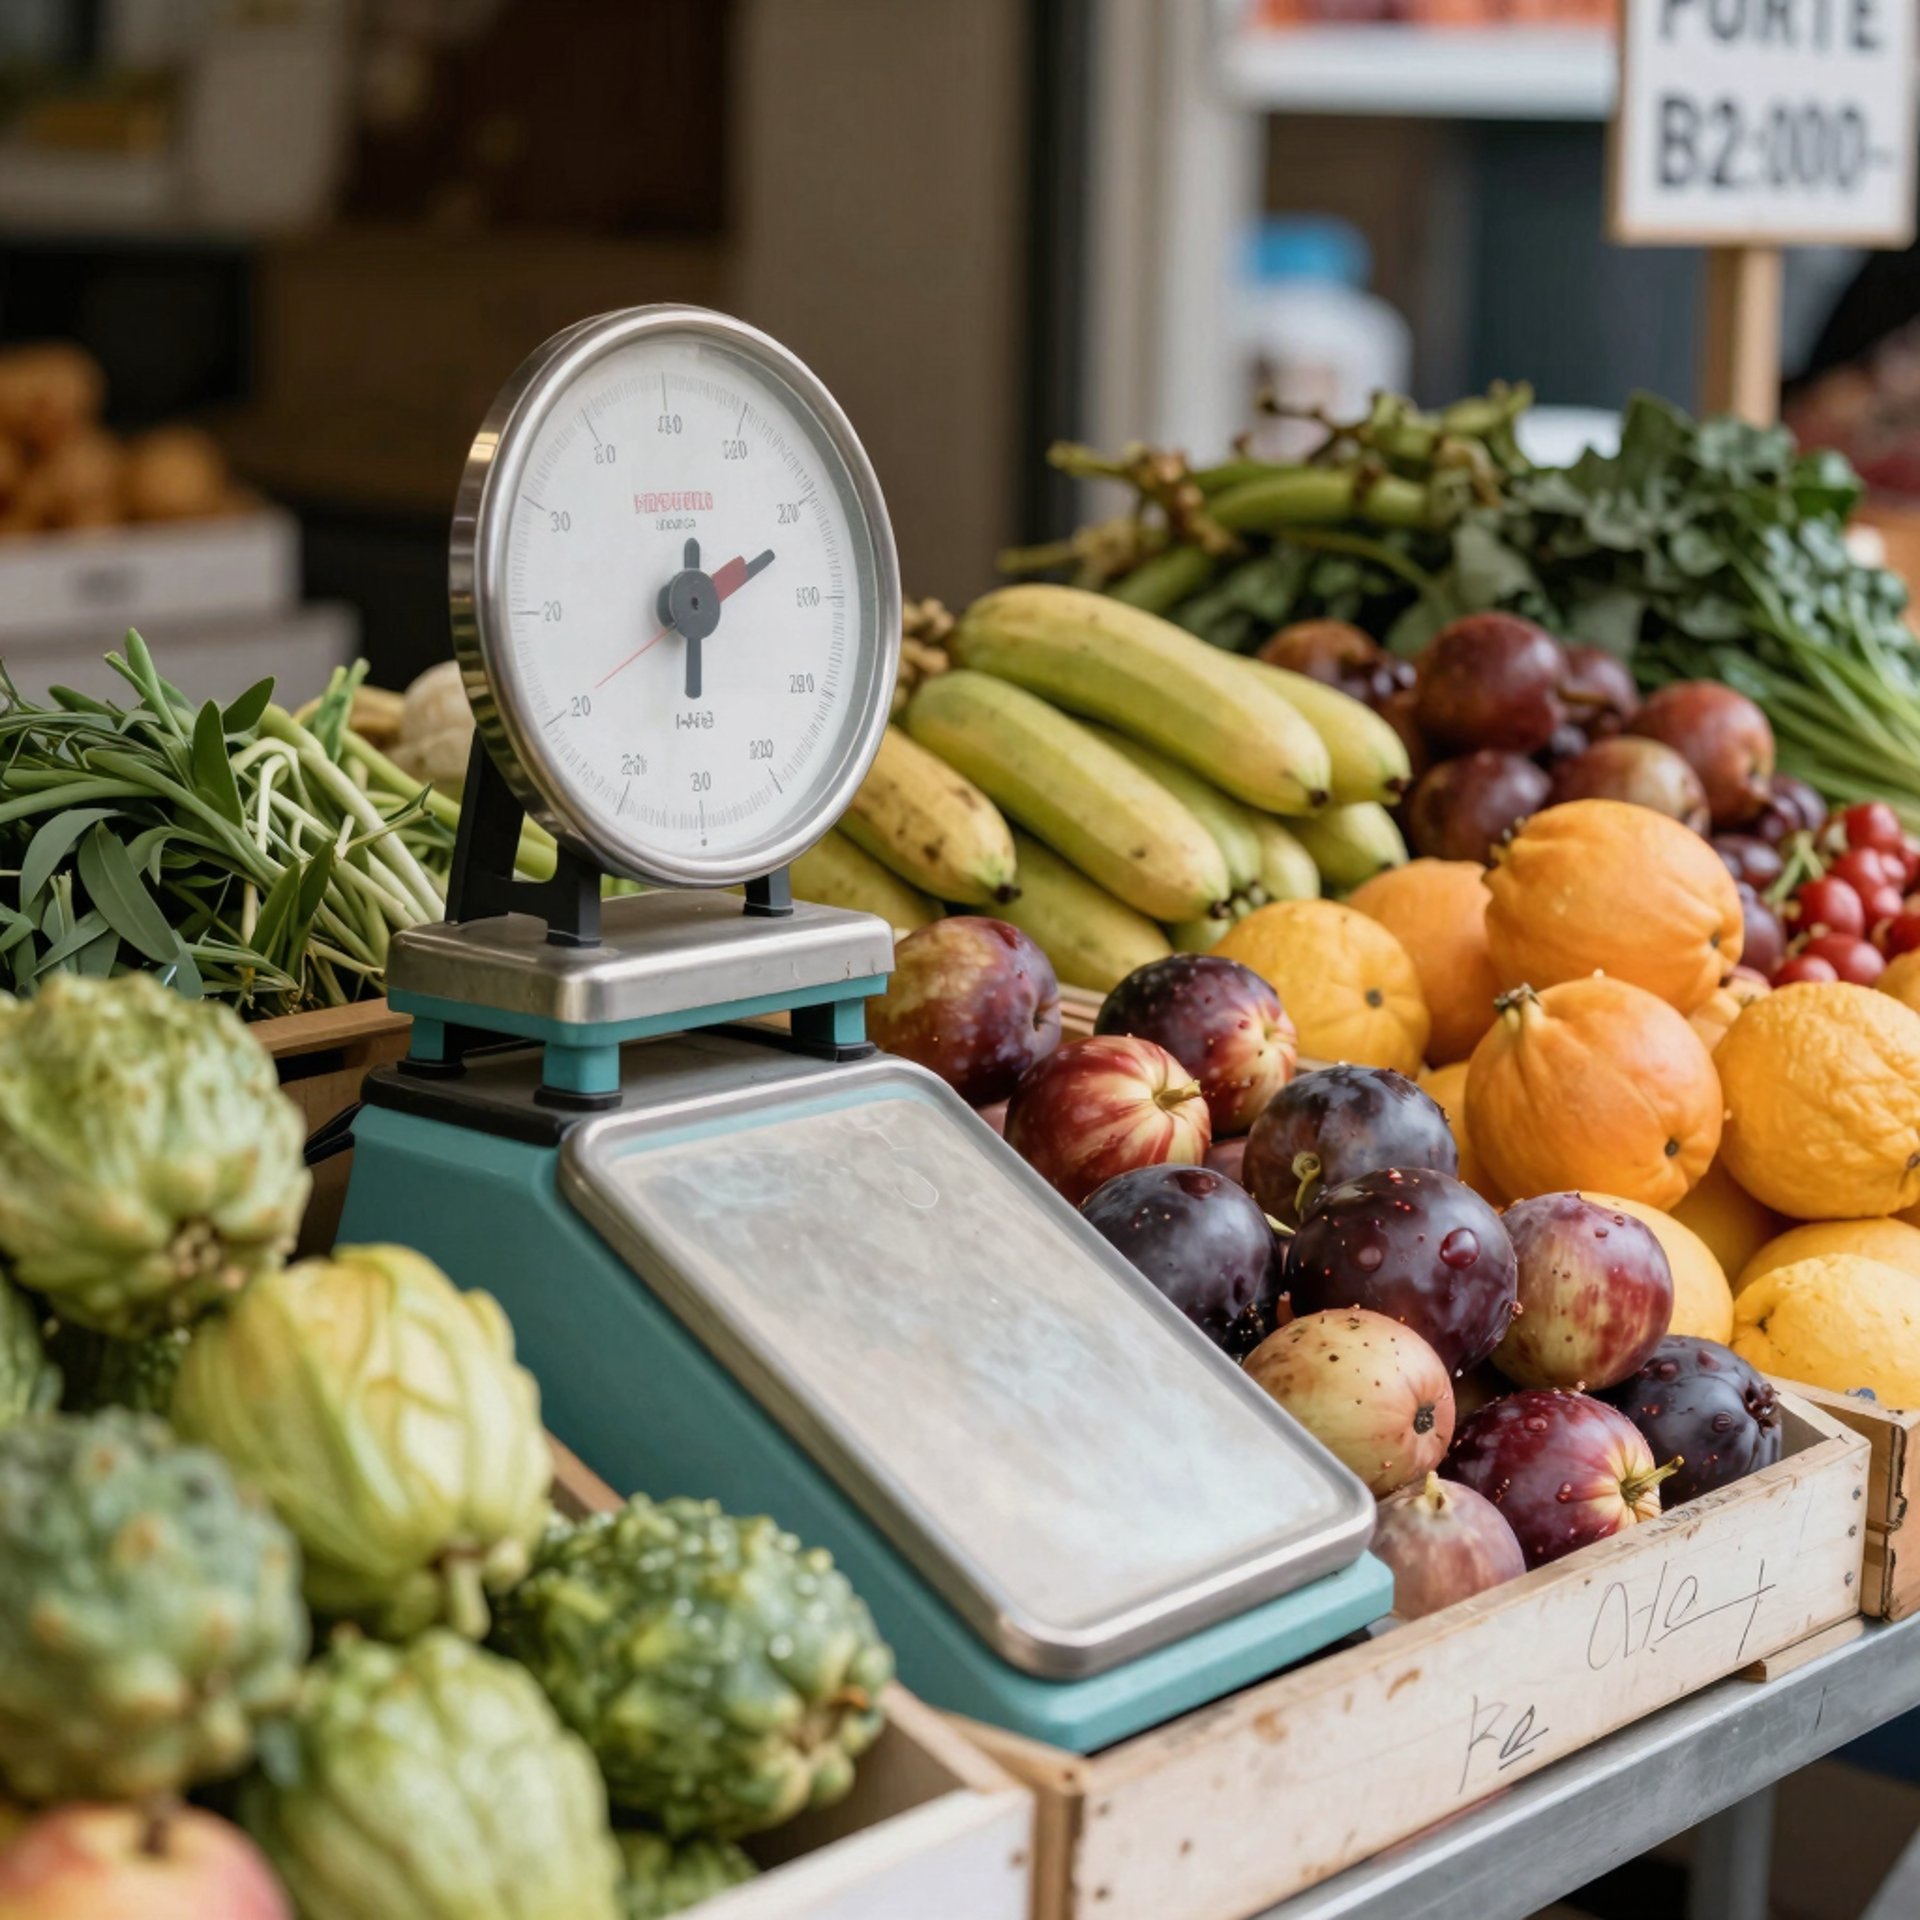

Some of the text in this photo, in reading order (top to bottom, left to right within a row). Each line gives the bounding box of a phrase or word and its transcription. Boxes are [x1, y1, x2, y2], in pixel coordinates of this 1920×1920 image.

[549, 511, 571, 532] 30
[543, 600, 562, 622] 20
[571, 695, 591, 716] 20
